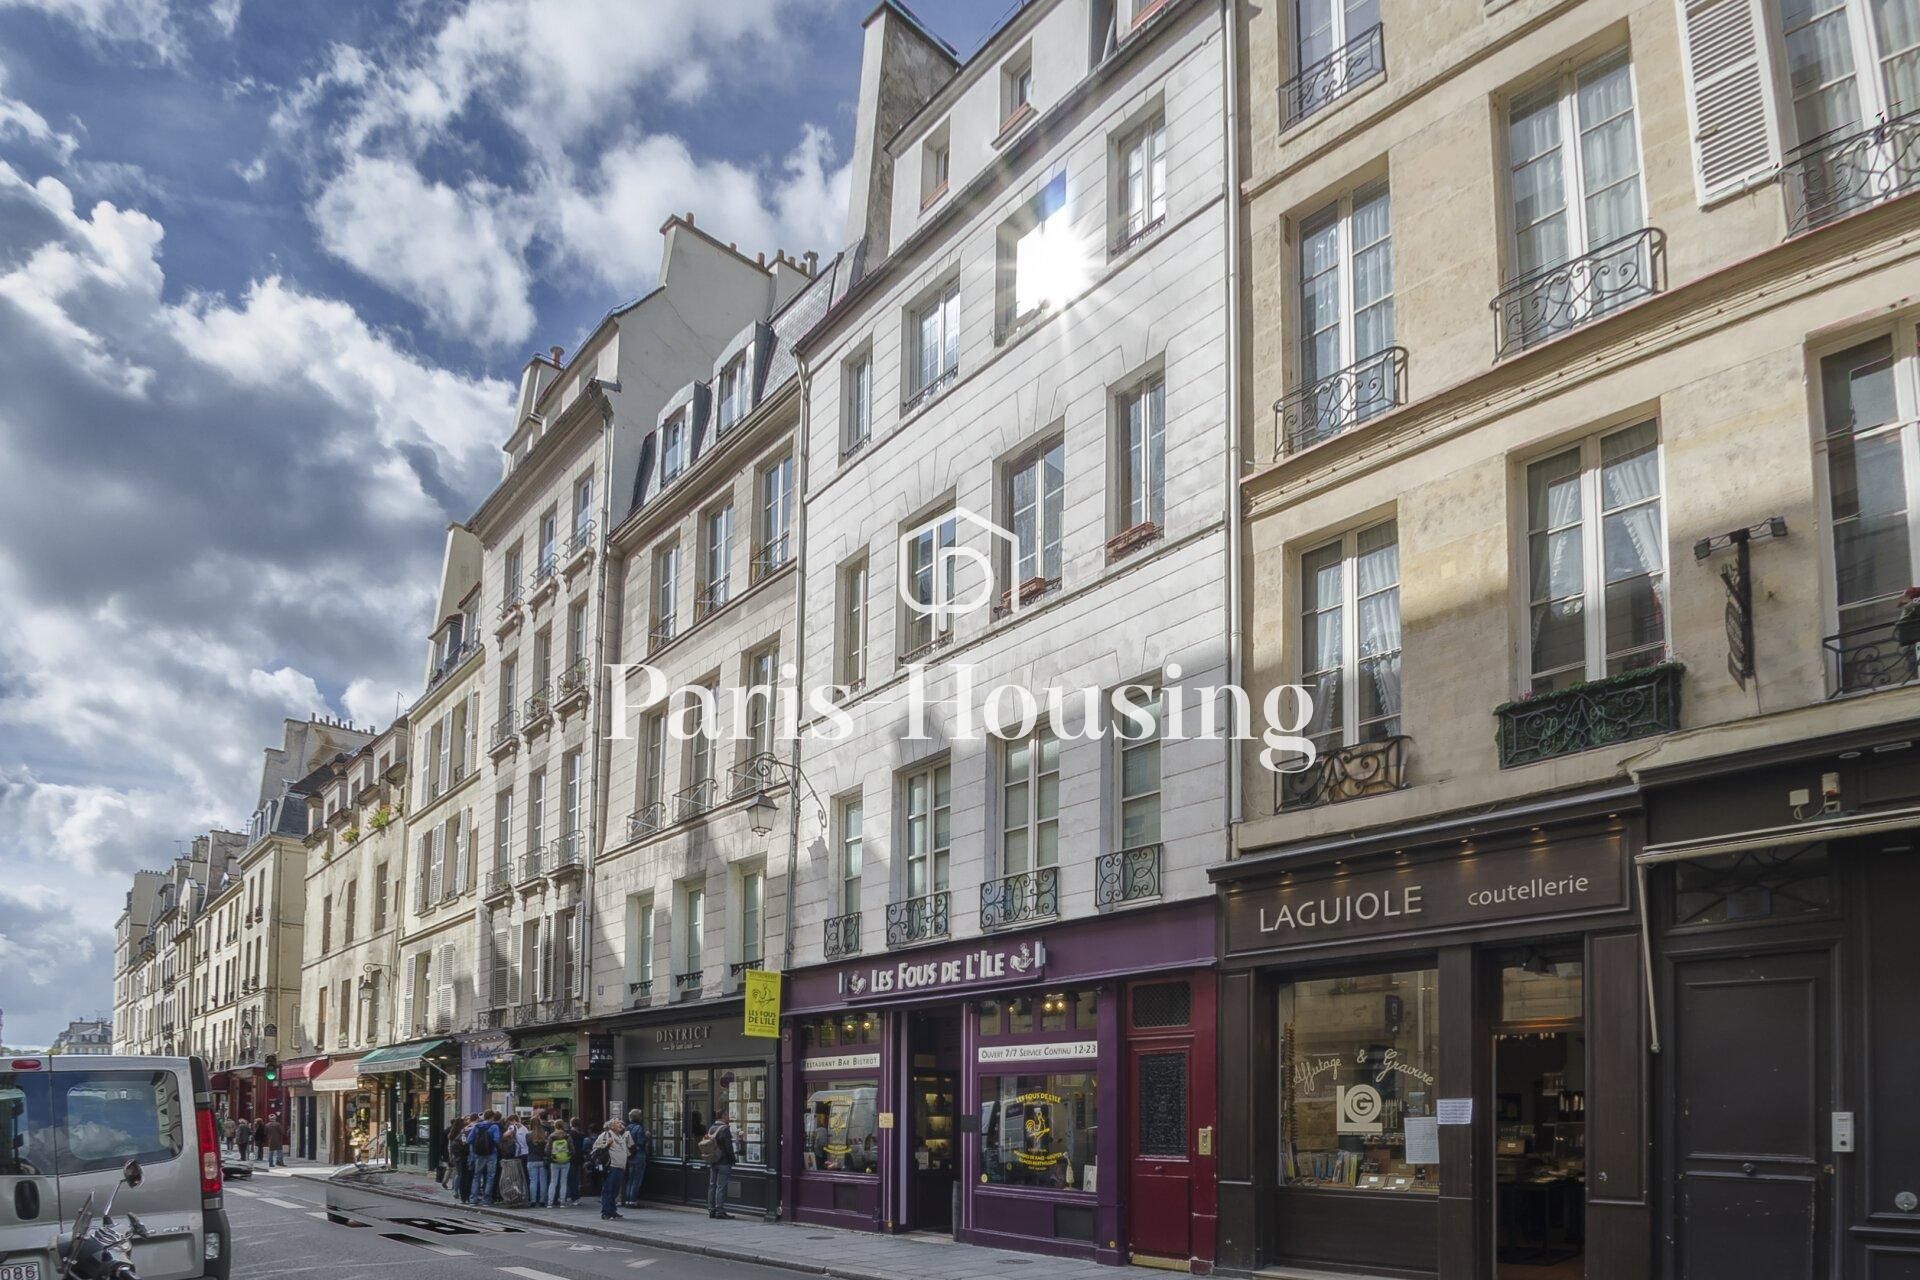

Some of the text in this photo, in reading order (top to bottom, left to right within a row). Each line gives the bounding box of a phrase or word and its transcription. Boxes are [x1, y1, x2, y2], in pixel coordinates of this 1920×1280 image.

[1259, 874, 1589, 933] LAGUIOLE coutellerie
[871, 970, 894, 993] LES
[898, 962, 938, 989] FOUS
[941, 960, 961, 984] DE
[656, 1025, 709, 1042] DISTRICT
[852, 1057, 877, 1066] BISTROT
[1005, 1048, 1018, 1058] 7/7
[1074, 1044, 1097, 1054] 12-23
[1293, 1048, 1435, 1095] Affutage & Gravure
